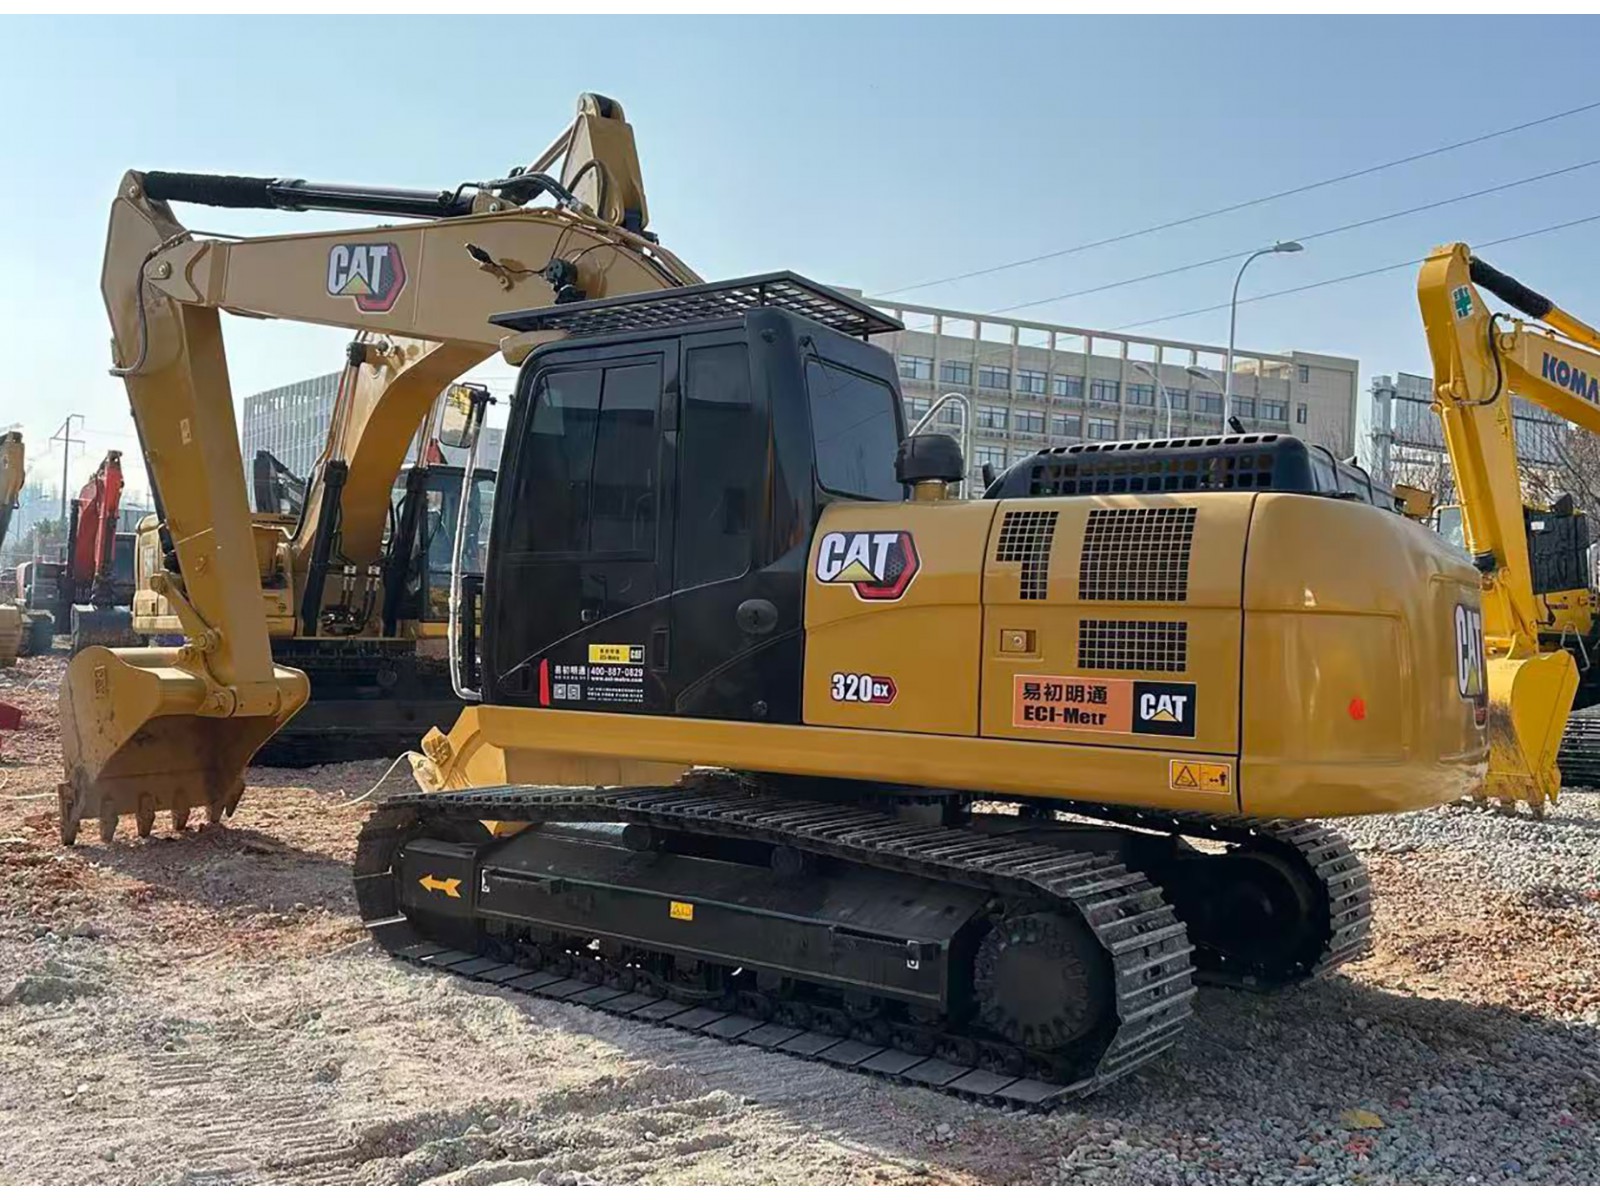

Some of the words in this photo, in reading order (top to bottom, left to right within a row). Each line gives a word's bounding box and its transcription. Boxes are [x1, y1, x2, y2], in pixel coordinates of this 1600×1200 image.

[328, 244, 389, 295] CAT
[817, 532, 899, 582] CAT
[1456, 604, 1483, 695] CAT
[591, 666, 643, 677] 400-887-0829
[1023, 682, 1108, 705] 易初明通
[1139, 692, 1188, 723] CAT
[1023, 704, 1108, 726] ECI-Metr
